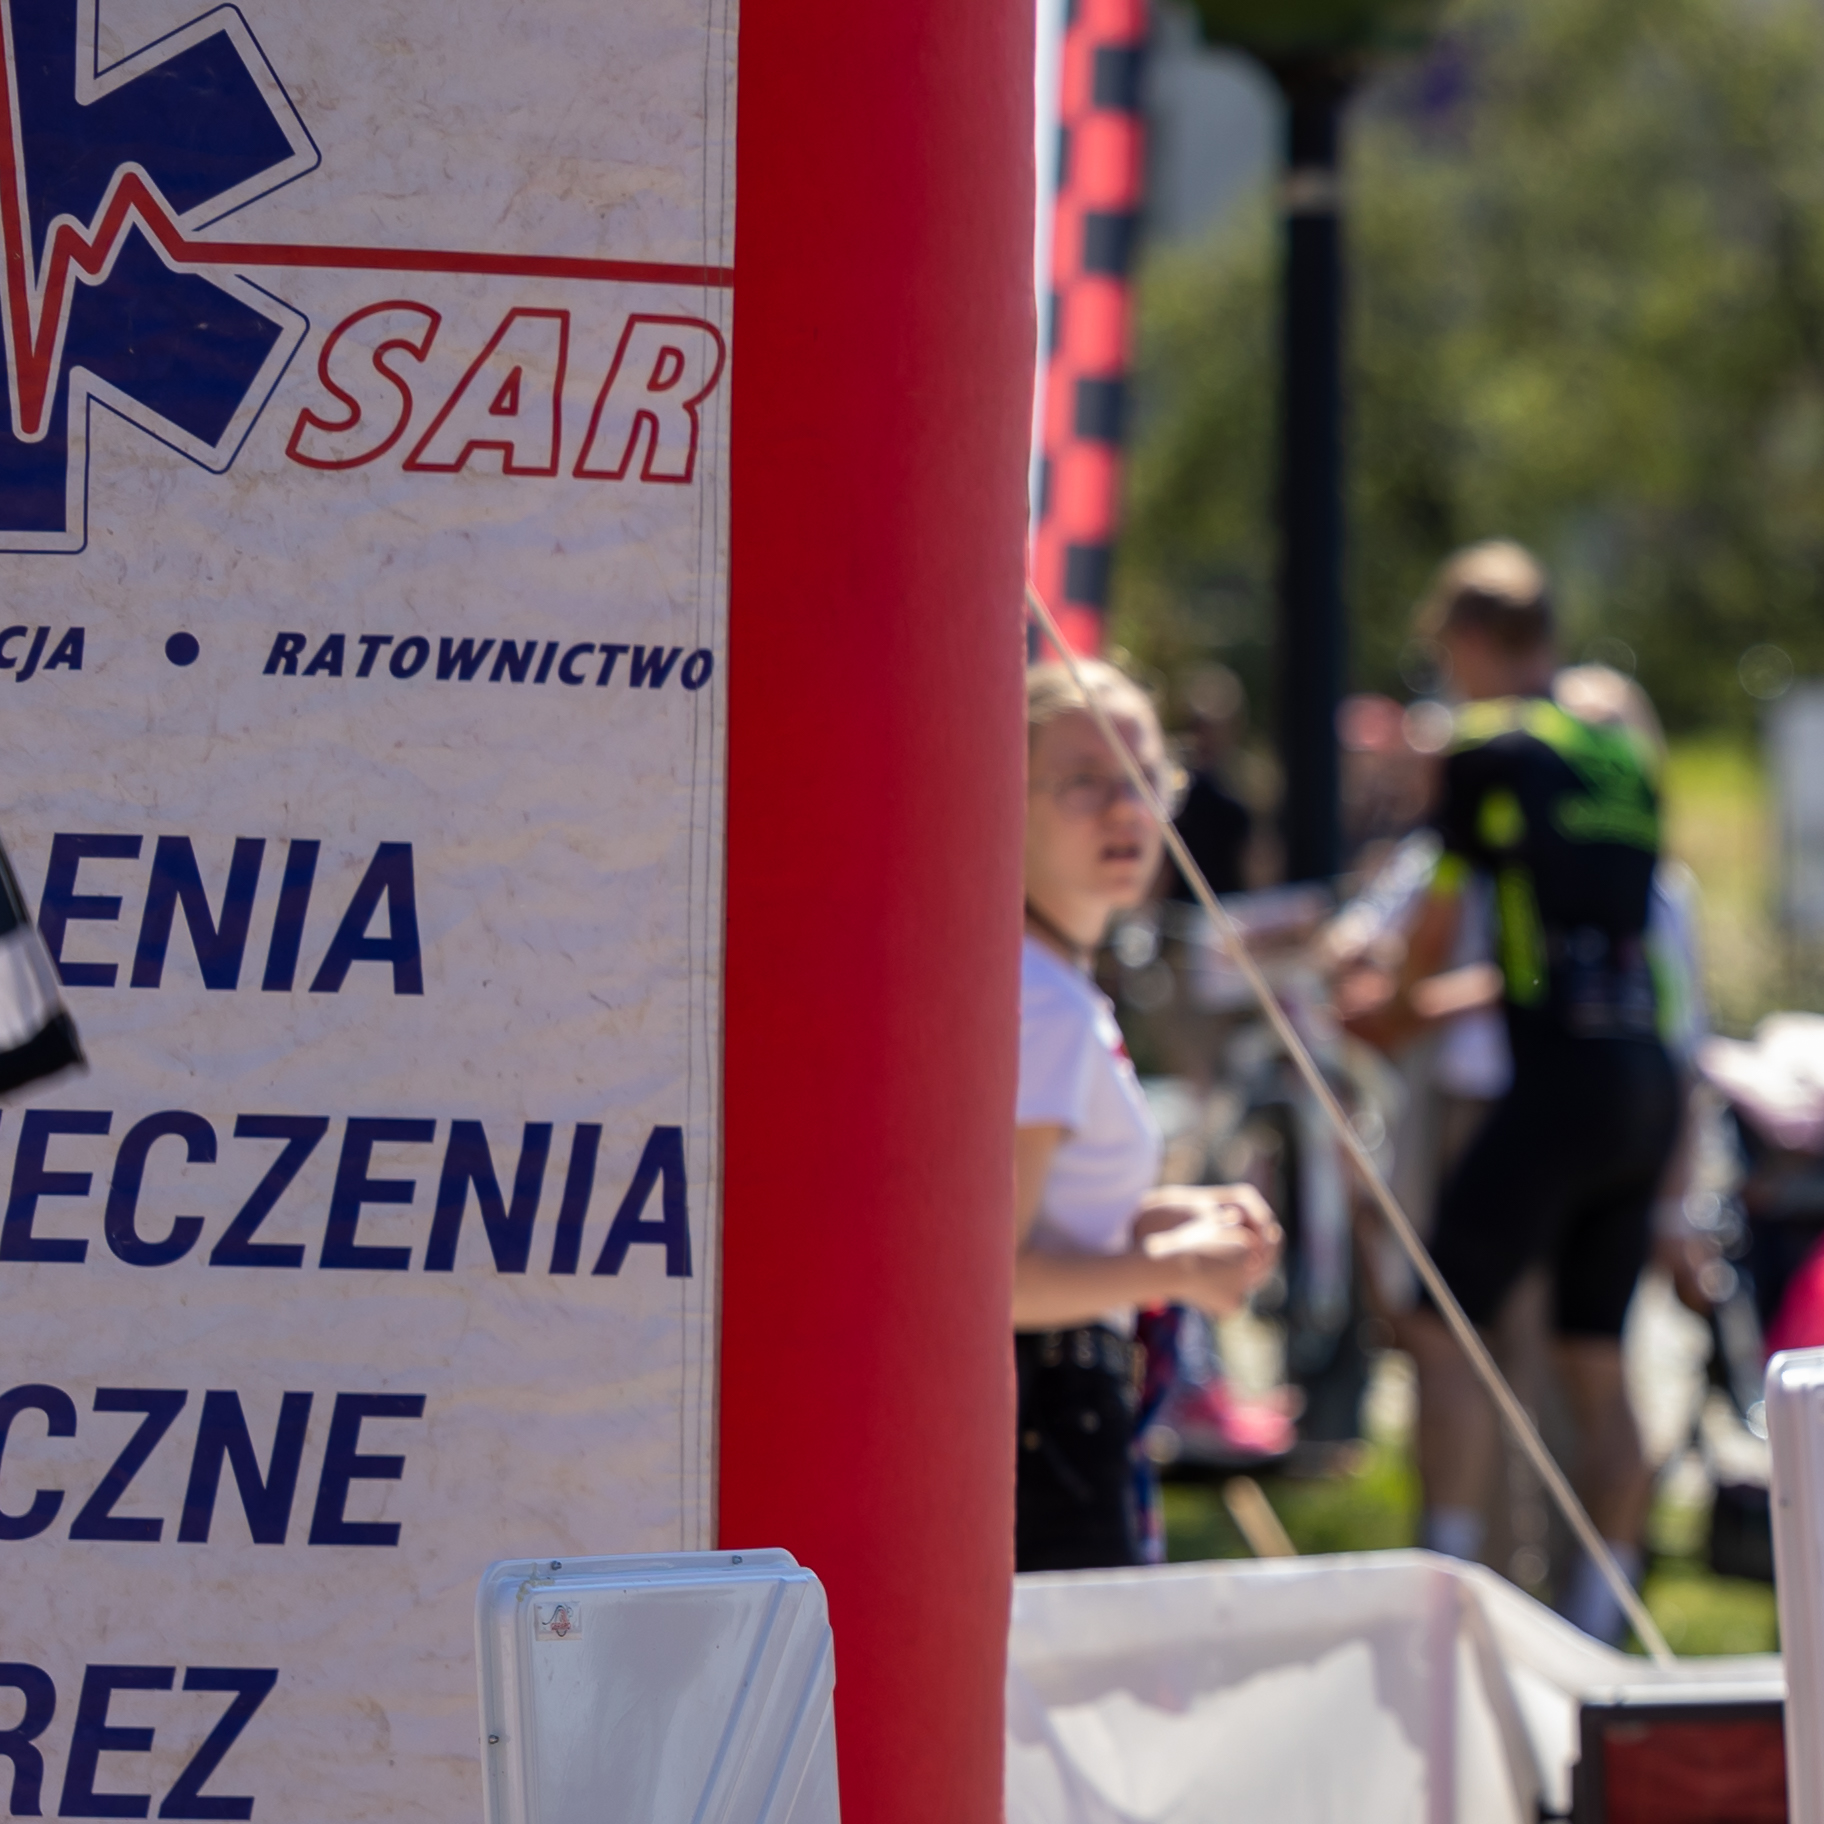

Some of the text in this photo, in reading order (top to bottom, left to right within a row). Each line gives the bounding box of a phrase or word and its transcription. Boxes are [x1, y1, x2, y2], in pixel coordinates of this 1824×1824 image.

[285, 299, 727, 484] SAR
[0, 625, 715, 691] CJA RATOWNICTWO
[37, 832, 424, 996] ENIA
[0, 1108, 693, 1277] ECZENIA
[0, 1383, 427, 1546] CZNE
[0, 1662, 279, 1821] REZ
